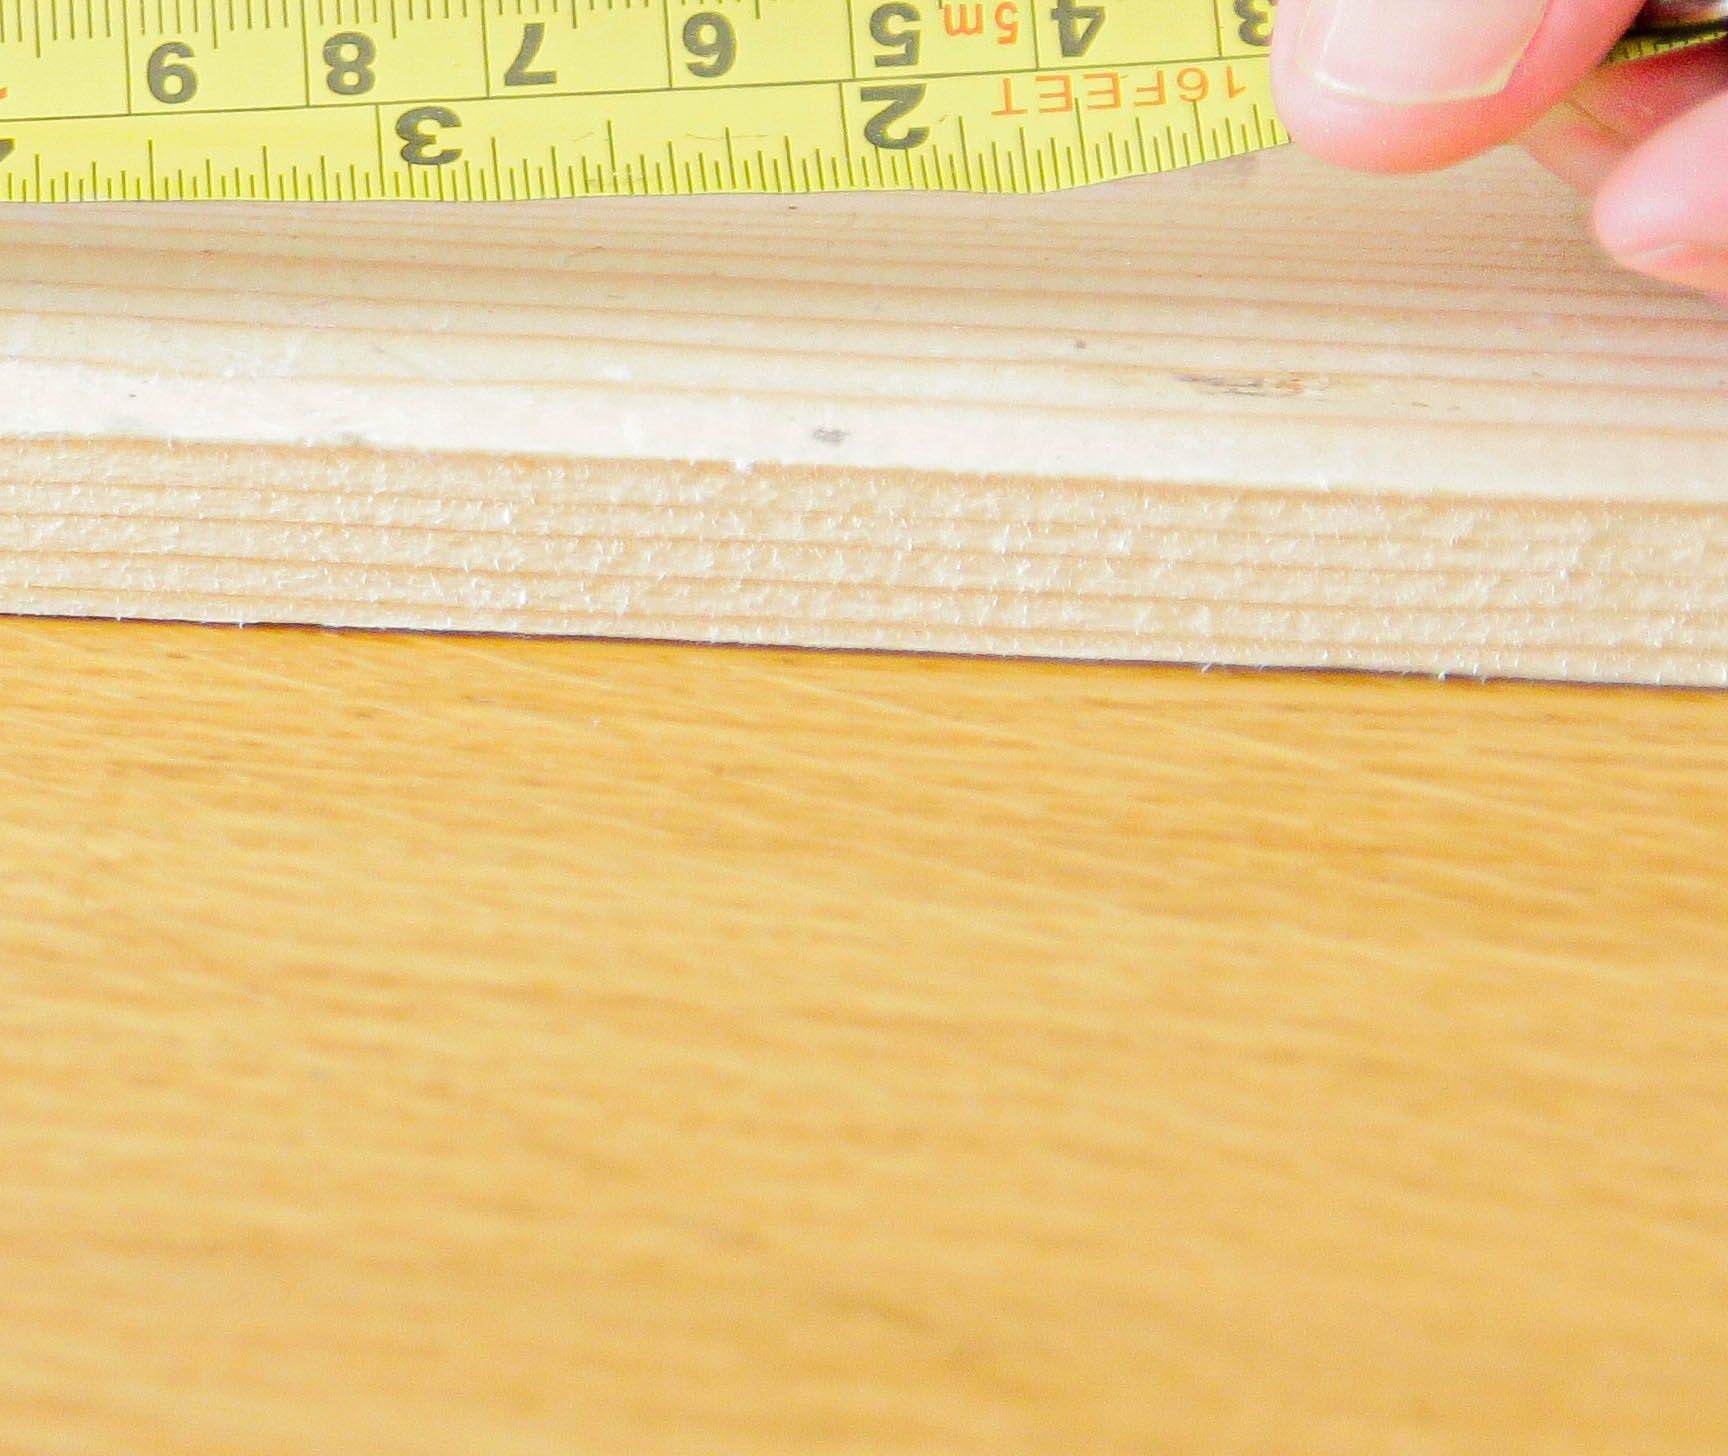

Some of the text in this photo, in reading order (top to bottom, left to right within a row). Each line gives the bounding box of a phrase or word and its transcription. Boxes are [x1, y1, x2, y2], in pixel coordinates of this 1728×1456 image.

[503, 22, 557, 87] 7
[681, 11, 738, 78] 6
[869, 1, 924, 68] 5
[942, 2, 1019, 45] 5m
[147, 41, 199, 104] 9
[322, 31, 377, 96] 8
[395, 106, 463, 166] 3
[860, 83, 930, 150] 2
